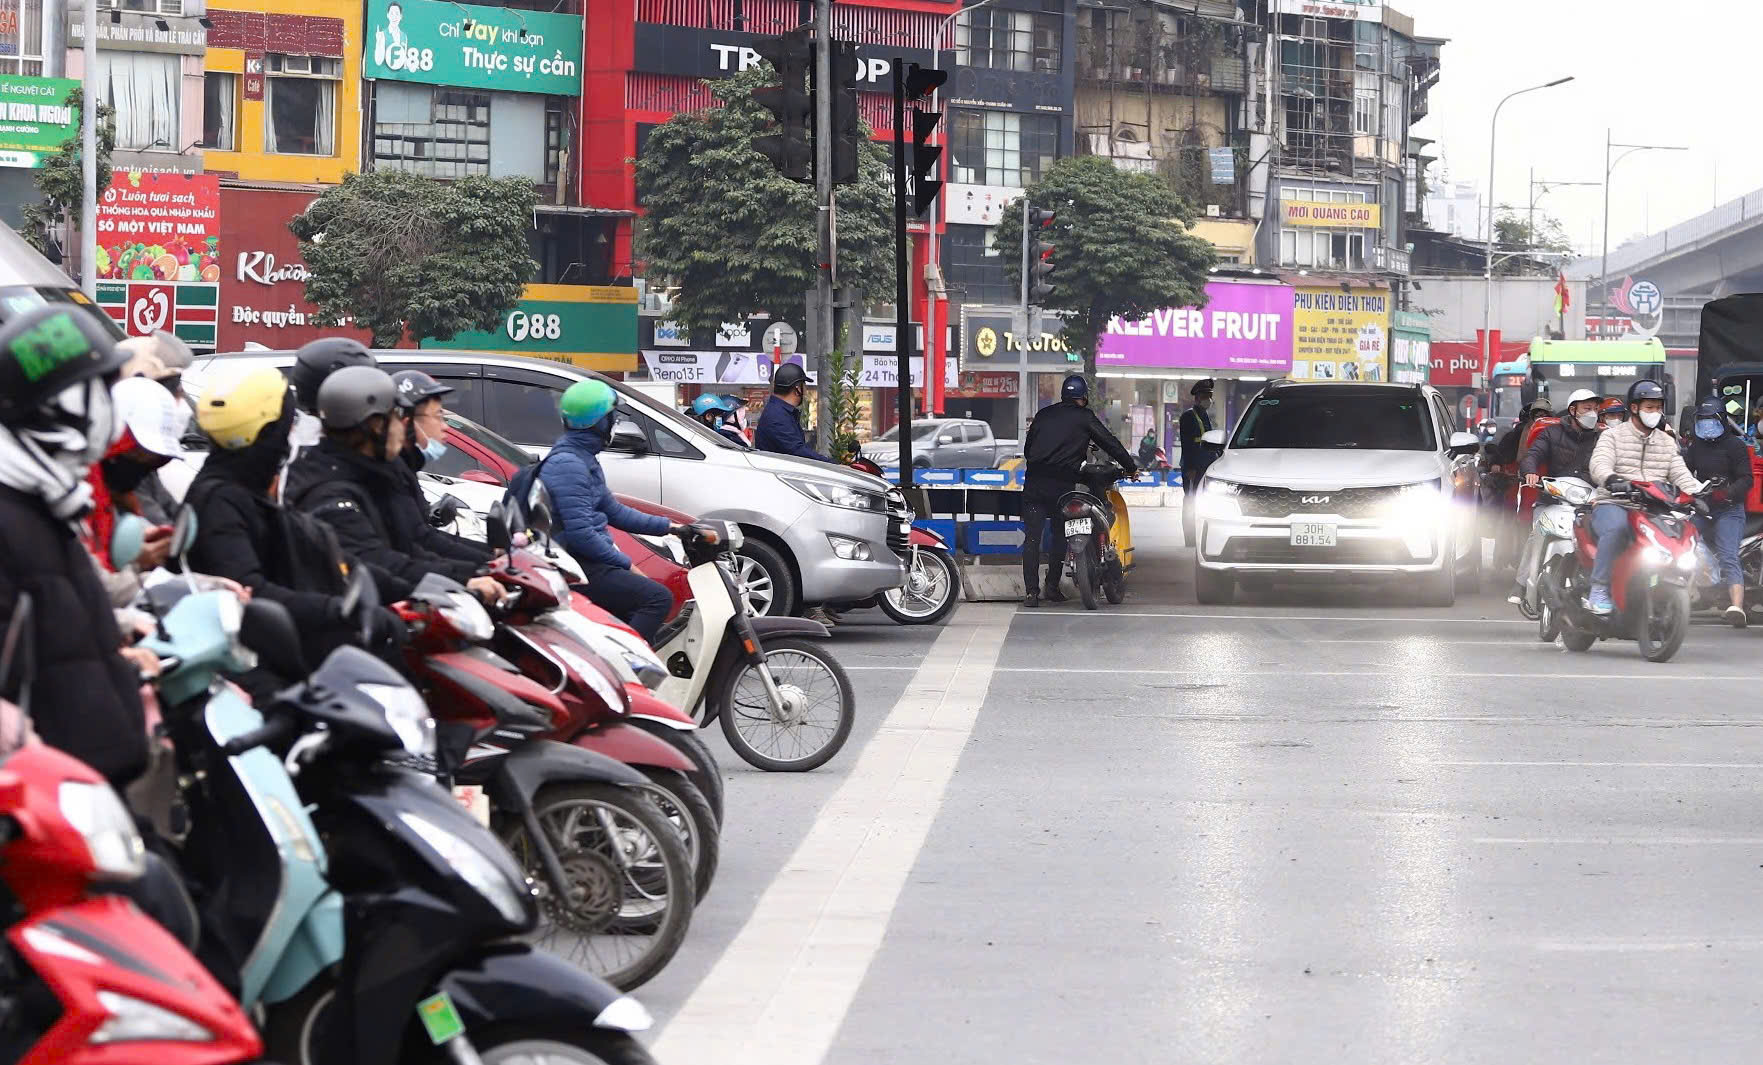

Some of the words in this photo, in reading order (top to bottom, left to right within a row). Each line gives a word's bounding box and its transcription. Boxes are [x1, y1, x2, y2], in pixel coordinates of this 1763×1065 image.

[463, 19, 499, 45] Vay
[502, 30, 518, 44] khi
[463, 47, 508, 75] Thực
[514, 53, 536, 79] sự
[540, 50, 576, 77] cần
[8, 102, 37, 122] KHOA
[131, 206, 150, 216] HOA
[98, 218, 115, 232] SỐ
[118, 220, 145, 235] MỘT
[148, 220, 173, 235] VIỆT
[176, 223, 205, 235] NAM
[232, 305, 260, 327] Độc
[262, 303, 305, 329] quyền
[507, 310, 561, 342] F88
[1211, 311, 1281, 341] FRUIT
[1359, 338, 1370, 351] GIÁ
[653, 367, 694, 380] Reno13
[697, 368, 704, 380] F
[865, 370, 879, 381] 24
[1301, 496, 1330, 504] KIA
[1304, 524, 1324, 535] 30H
[1295, 535, 1332, 546] 881.54
